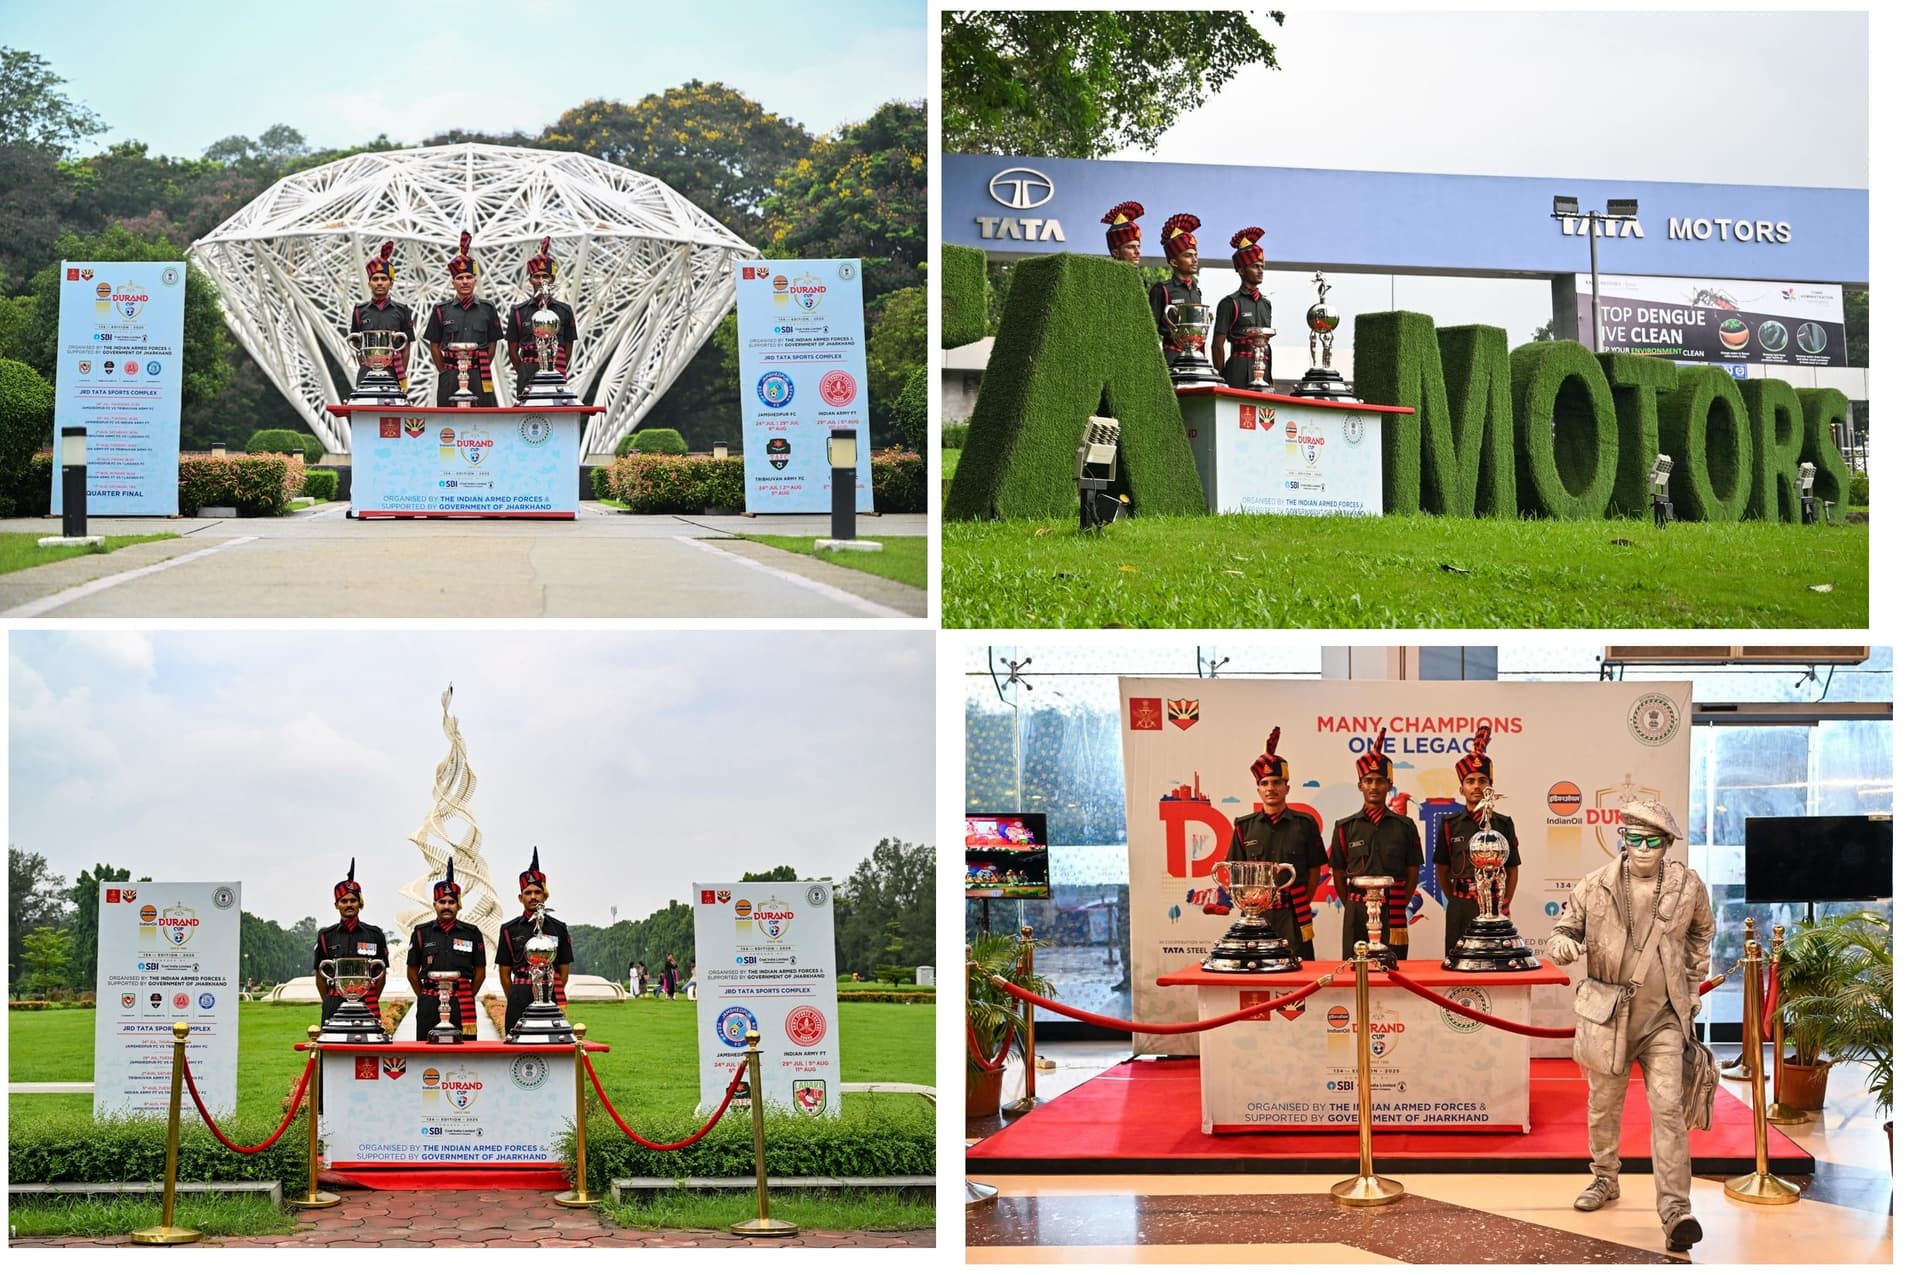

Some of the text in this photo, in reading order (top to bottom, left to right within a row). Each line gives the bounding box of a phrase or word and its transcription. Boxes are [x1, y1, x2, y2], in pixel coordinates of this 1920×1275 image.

[976, 216, 1066, 242] TATA
[1555, 213, 1792, 244] TATA MOTORS
[790, 286, 827, 294] DURAND
[1601, 307, 1706, 326] TOP DENGUE
[1601, 326, 1683, 344] IVE CLEAN
[1355, 310, 1849, 523] MOTORS
[456, 440, 494, 448] DURAND
[1298, 436, 1325, 446] DURAND
[446, 480, 458, 488] SBI
[1290, 481, 1299, 489] SBI
[439, 503, 491, 511] GOVERNMENT
[1317, 716, 1523, 733] MANY CHAMPIONS
[1586, 809, 1626, 825] DUR
[754, 912, 794, 920] DURAND
[159, 918, 200, 927] DURAND
[145, 962, 159, 971] SBI
[1352, 1024, 1405, 1033] DRAND
[441, 1082, 483, 1091] DURAND
[1337, 1081, 1354, 1091] SBI
[1247, 1103, 1487, 1112] ORGANISED BY THE IIAN ARMED FORCES &
[1244, 1113, 1489, 1123] SUPPORTED BY GOVEMENT OF JHARKHAND
[428, 1127, 443, 1136] SBI
[359, 1144, 408, 1152] ORGANISED
[409, 1144, 421, 1152] BY
[422, 1144, 439, 1152] THE
[441, 1144, 471, 1152] INDIAN
[472, 1144, 503, 1152] ARMED
[504, 1144, 538, 1152] FORCES
[357, 1153, 547, 1161] SUPPORTED BY GOVERNMENT OF JHARKHAND
